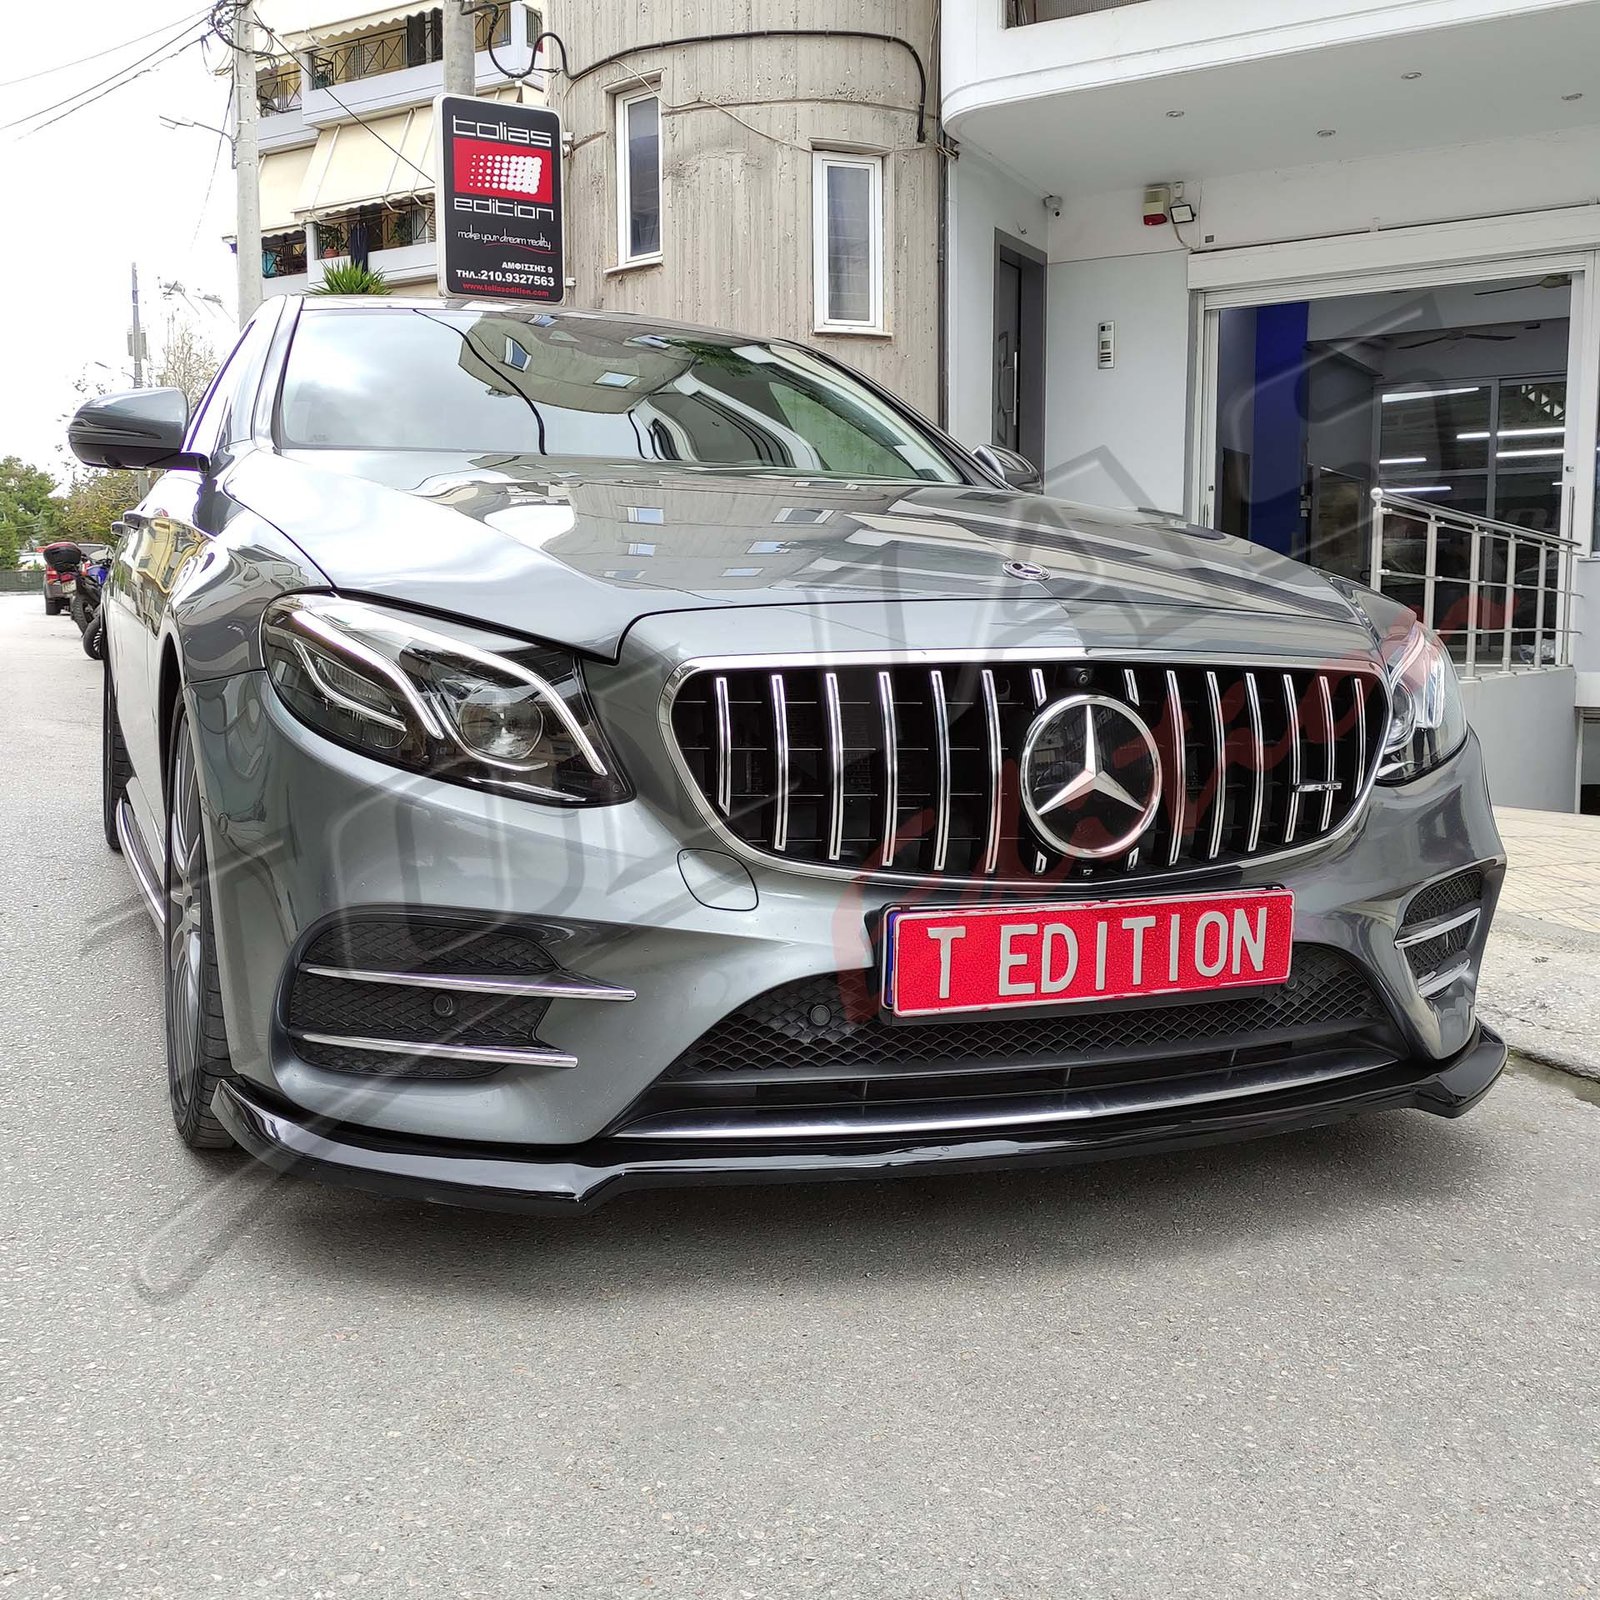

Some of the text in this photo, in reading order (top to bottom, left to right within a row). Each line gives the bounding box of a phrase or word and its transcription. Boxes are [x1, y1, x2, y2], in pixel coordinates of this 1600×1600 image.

[453, 115, 551, 147] tolias
[454, 198, 554, 221] edition
[457, 224, 551, 250] make your dream reality
[927, 906, 1267, 999] T EDITION
